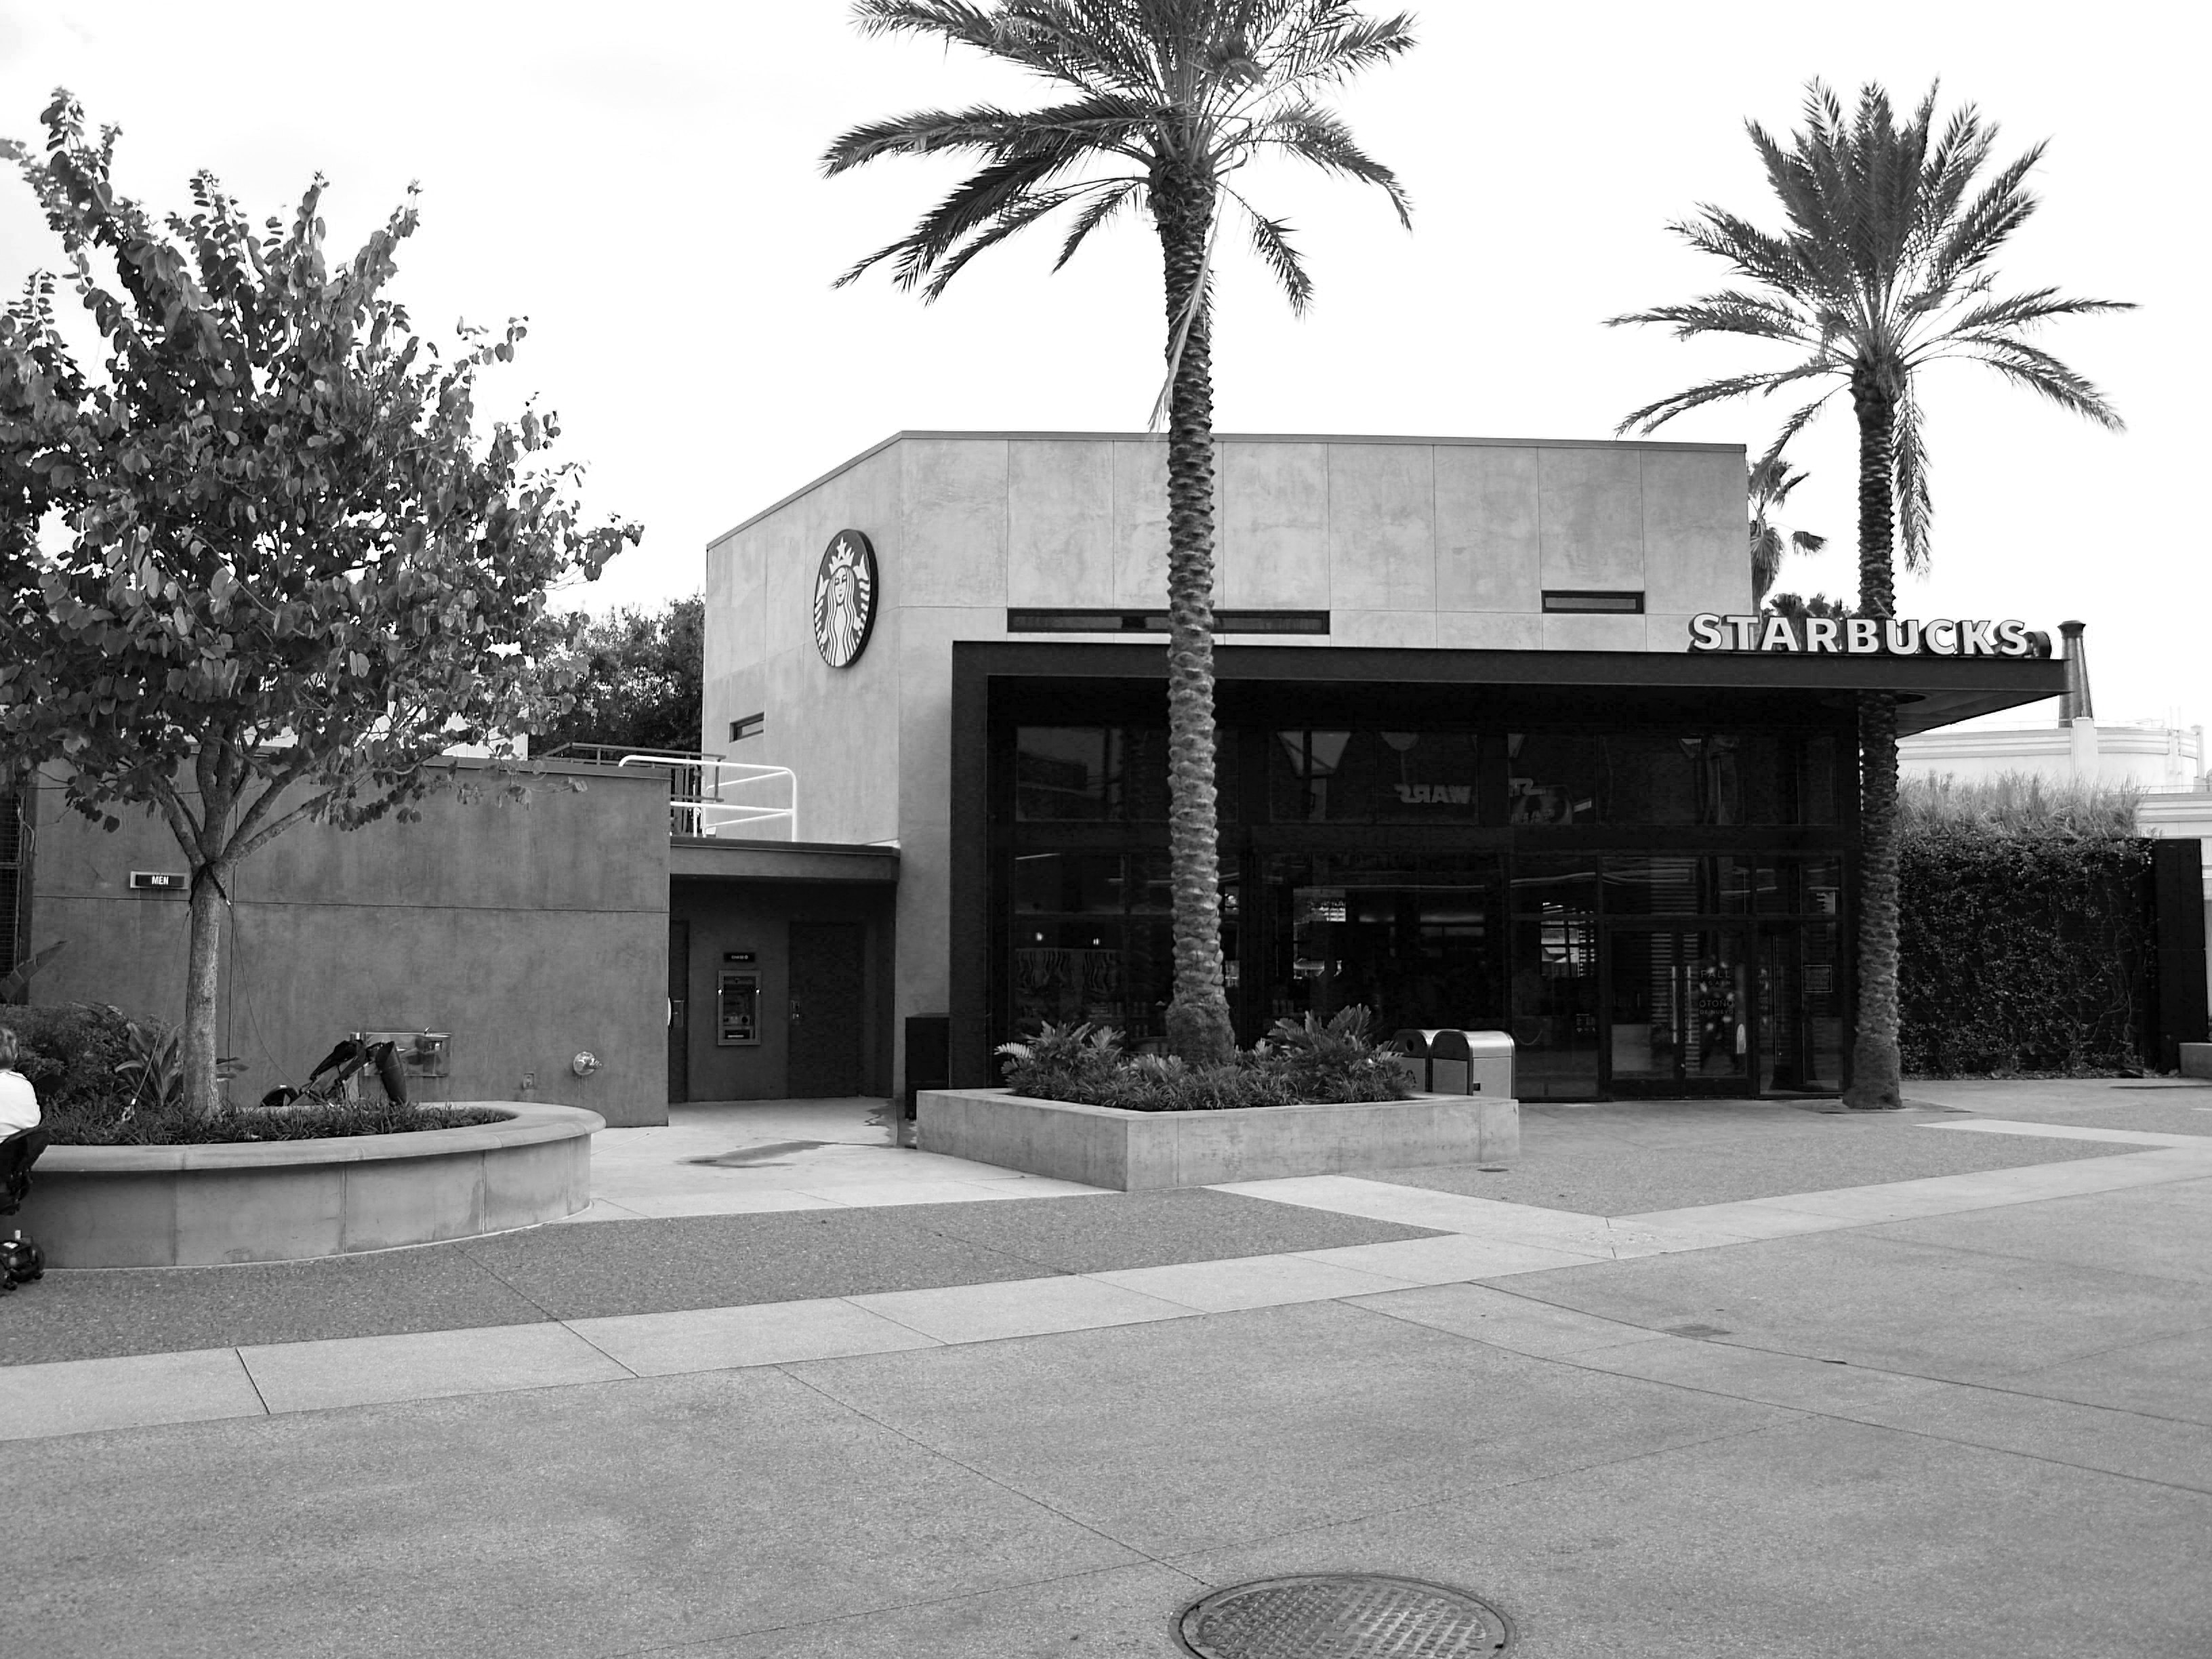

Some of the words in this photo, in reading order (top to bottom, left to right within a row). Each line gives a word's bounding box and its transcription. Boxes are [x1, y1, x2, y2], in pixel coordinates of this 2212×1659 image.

[1690, 612, 2028, 656] STARBUCKS
[152, 876, 169, 885] MEN
[1700, 970, 1731, 978] FALL
